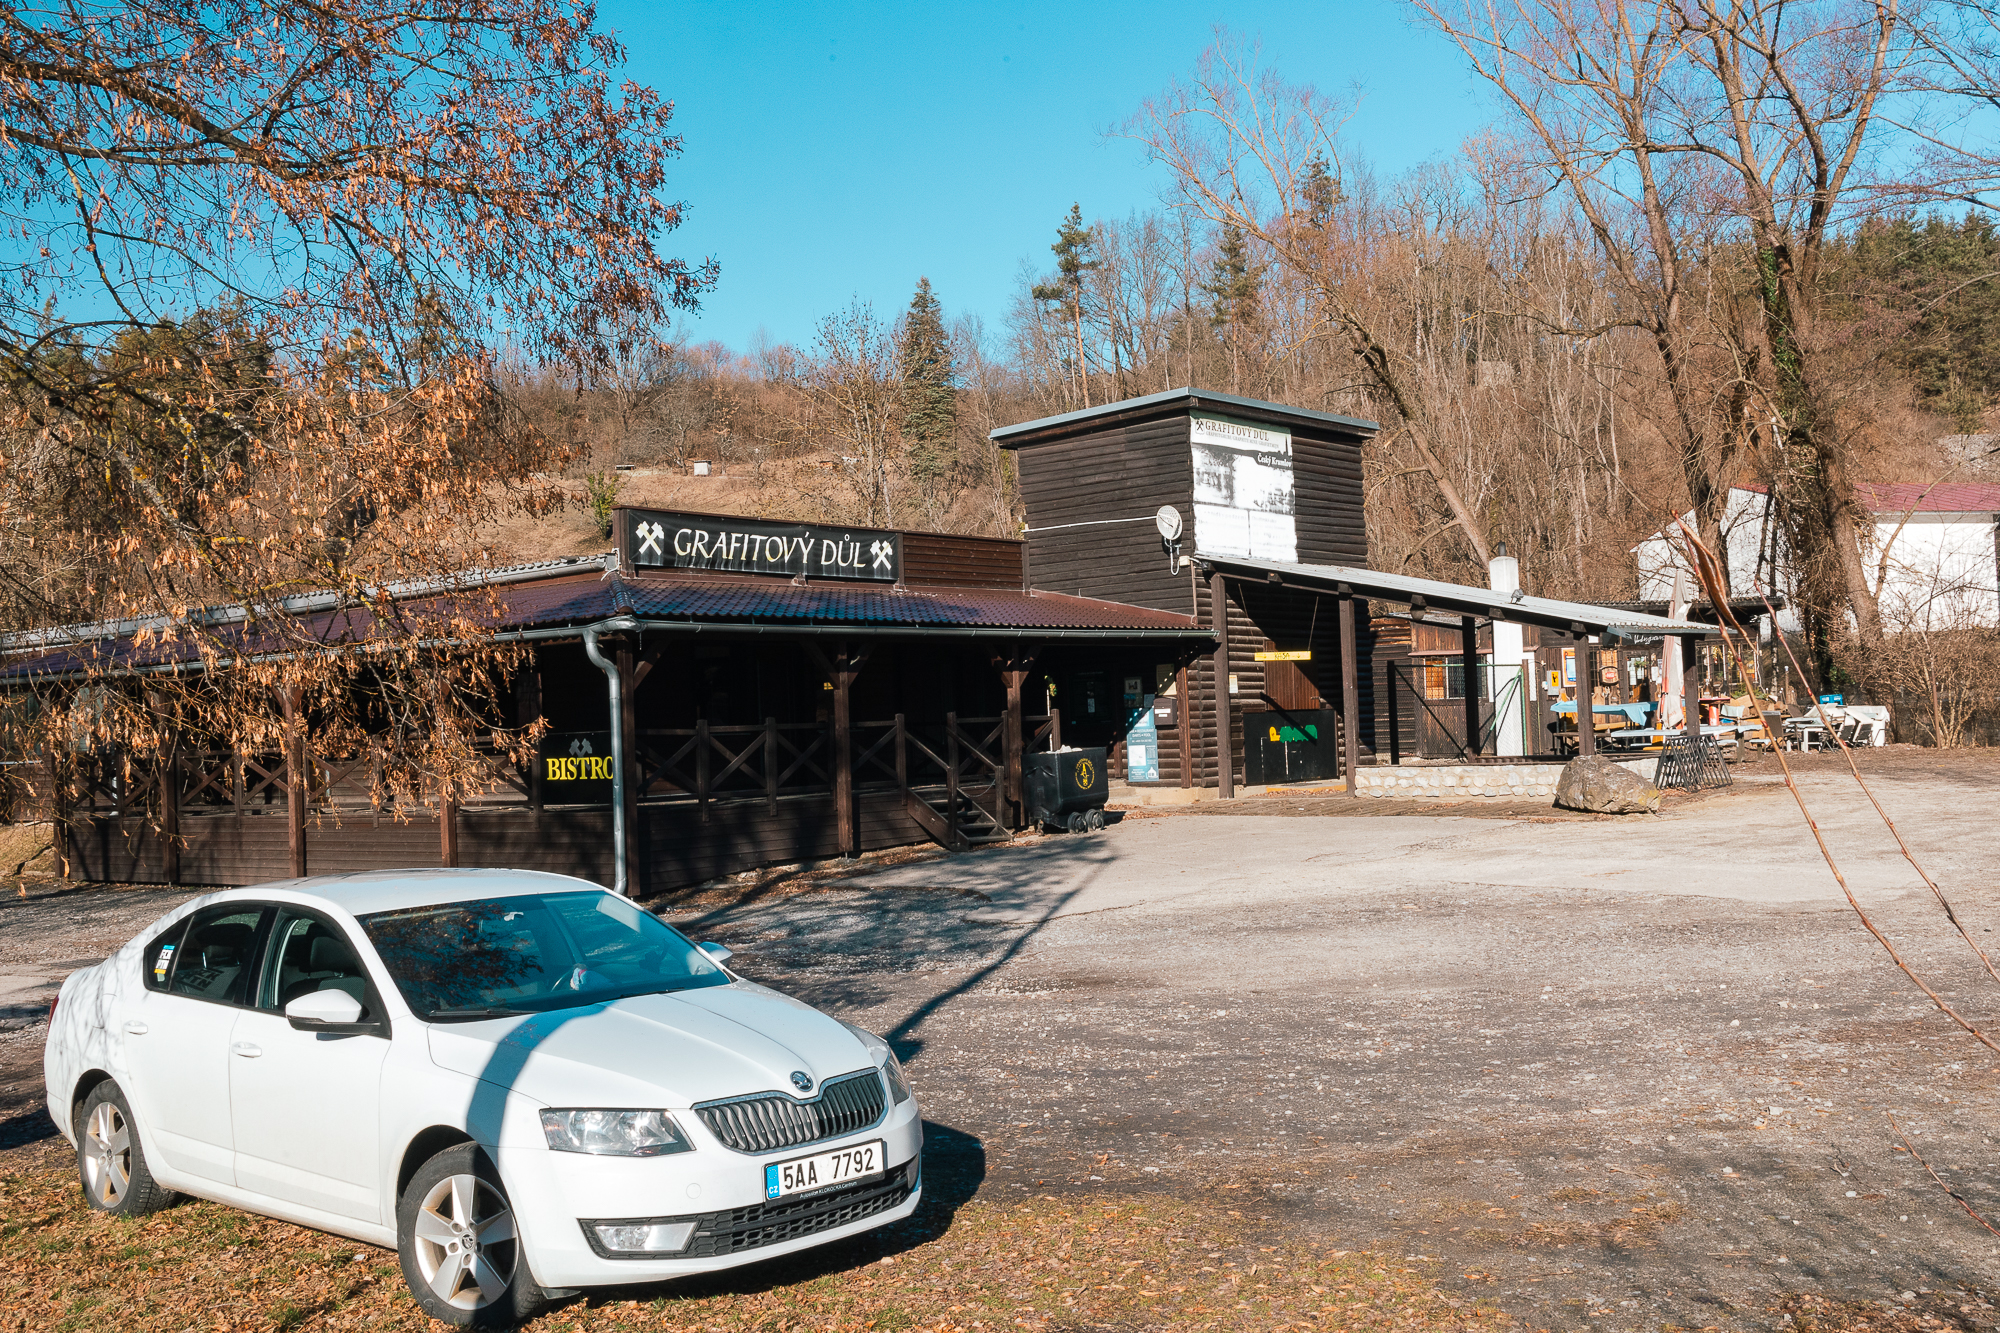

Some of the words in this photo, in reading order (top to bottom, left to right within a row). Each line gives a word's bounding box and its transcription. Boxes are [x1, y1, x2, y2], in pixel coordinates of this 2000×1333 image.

[1257, 452, 1271, 466] Český
[1271, 455, 1292, 467] Krumlov
[673, 528, 815, 564] GRAFITOVÝ
[820, 533, 866, 568] DŮL
[546, 755, 614, 780] BISTRO
[783, 1160, 818, 1190] 5AA
[831, 1147, 874, 1179] 7792
[768, 1184, 779, 1195] CZ
